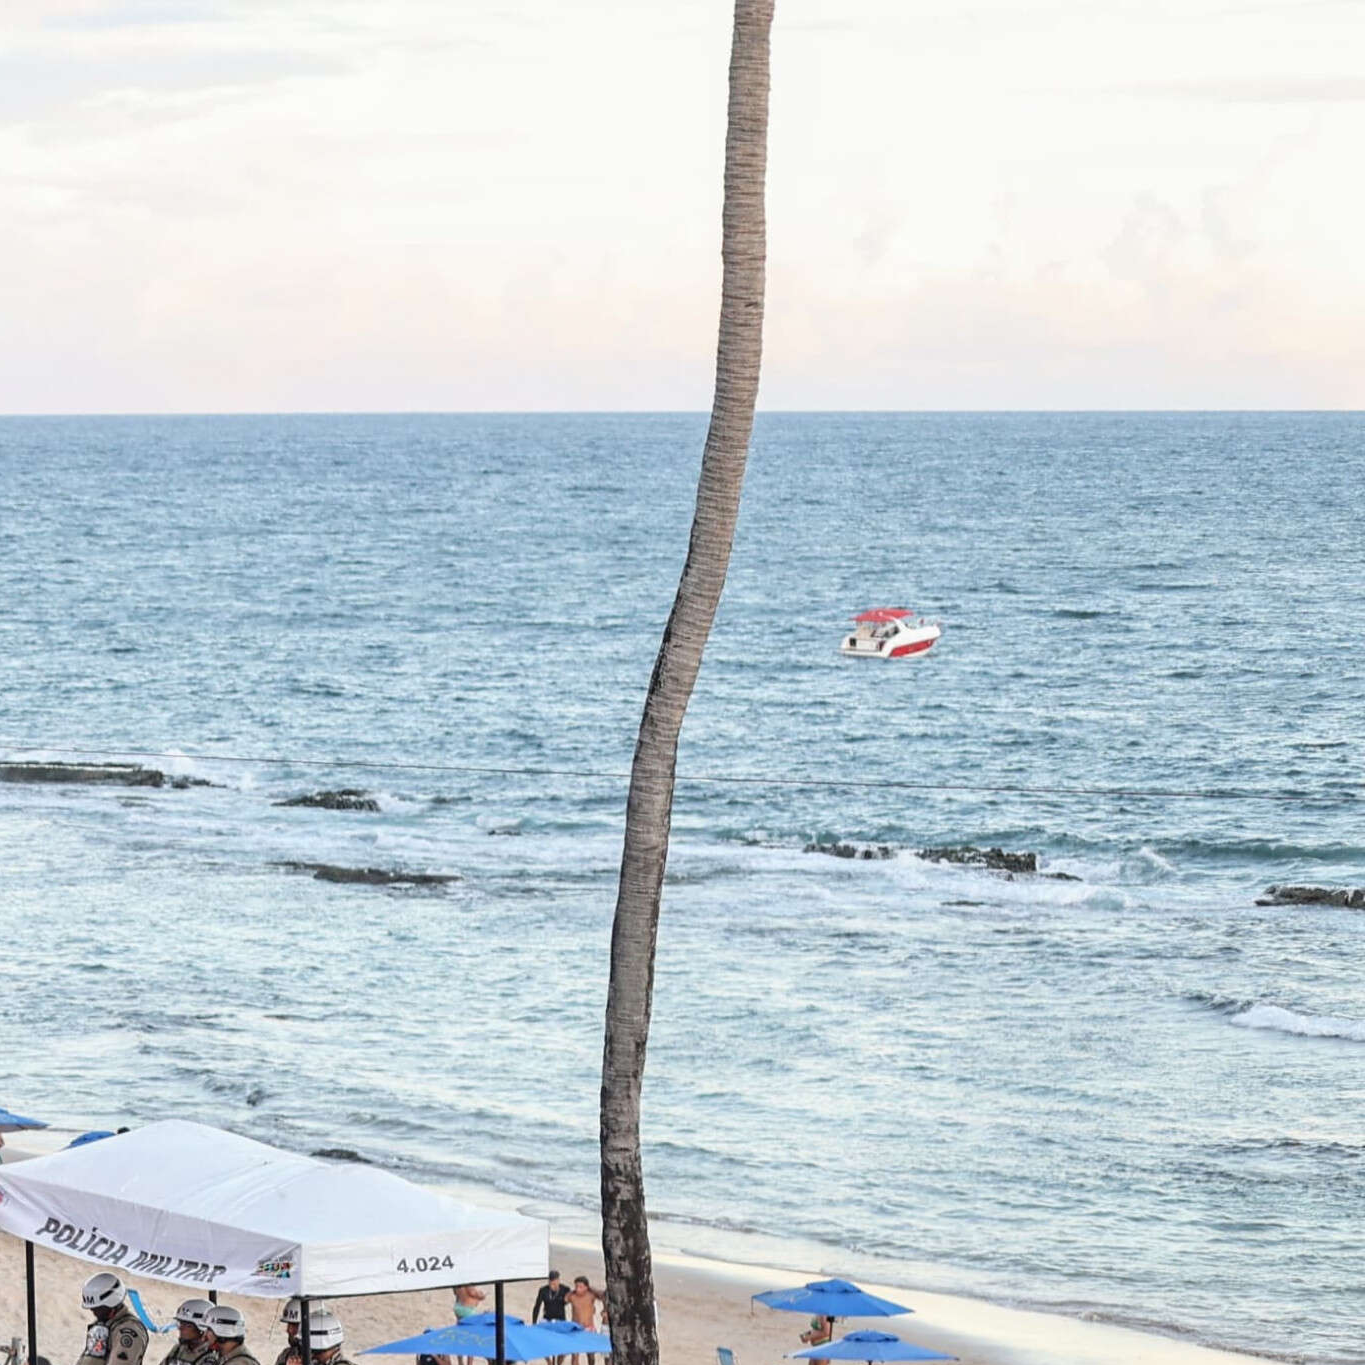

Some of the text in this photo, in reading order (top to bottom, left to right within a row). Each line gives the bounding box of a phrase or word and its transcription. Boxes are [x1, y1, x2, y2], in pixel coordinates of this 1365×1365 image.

[36, 1217, 129, 1265] POLÍCIA
[127, 1250, 228, 1284] MILITAR
[397, 1255, 454, 1273] 4.024
